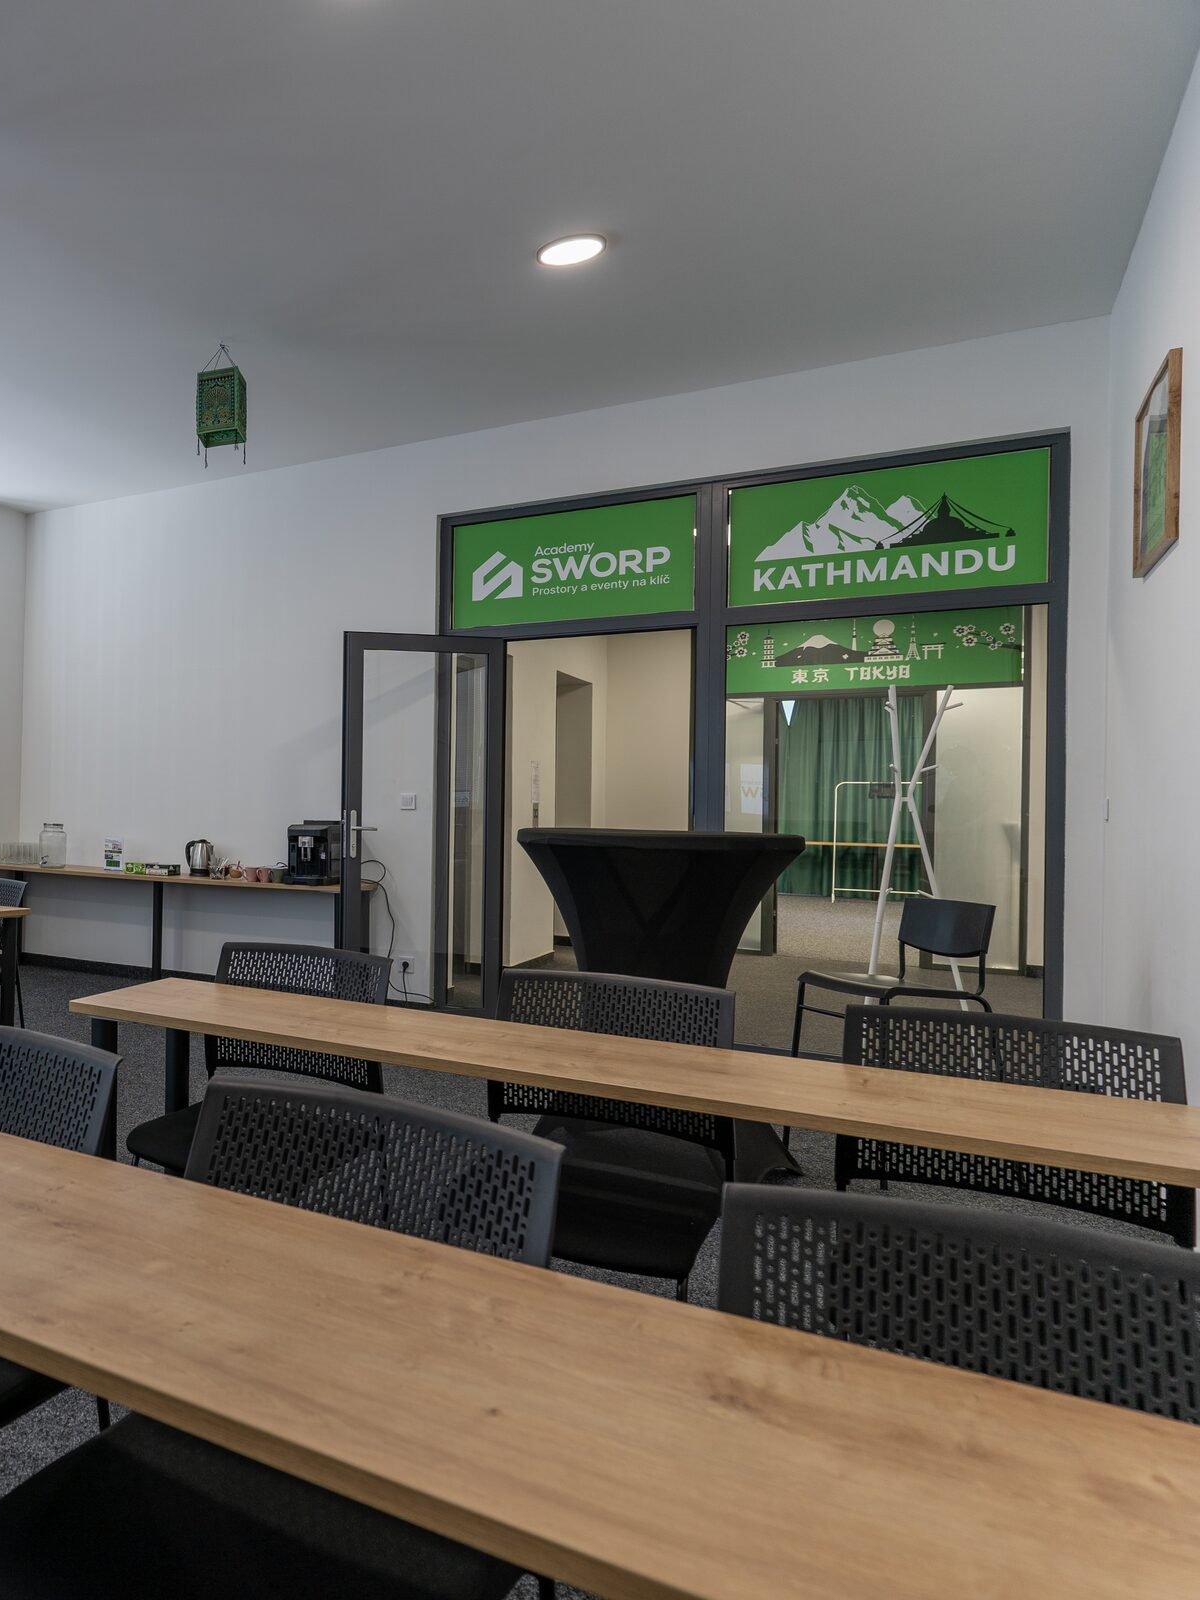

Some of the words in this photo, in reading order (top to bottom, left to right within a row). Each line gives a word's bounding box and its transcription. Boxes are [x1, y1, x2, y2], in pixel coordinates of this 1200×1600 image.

[534, 542, 595, 557] Academy
[530, 546, 671, 584] SWORP
[753, 545, 1017, 592] KATHMANDU
[532, 584, 578, 596] Prostory
[580, 584, 588, 592] a
[590, 578, 629, 591] eventy
[632, 577, 646, 587] na
[649, 574, 671, 585] klíč
[791, 668, 829, 684] 東京
[844, 665, 911, 682] TOKYO
